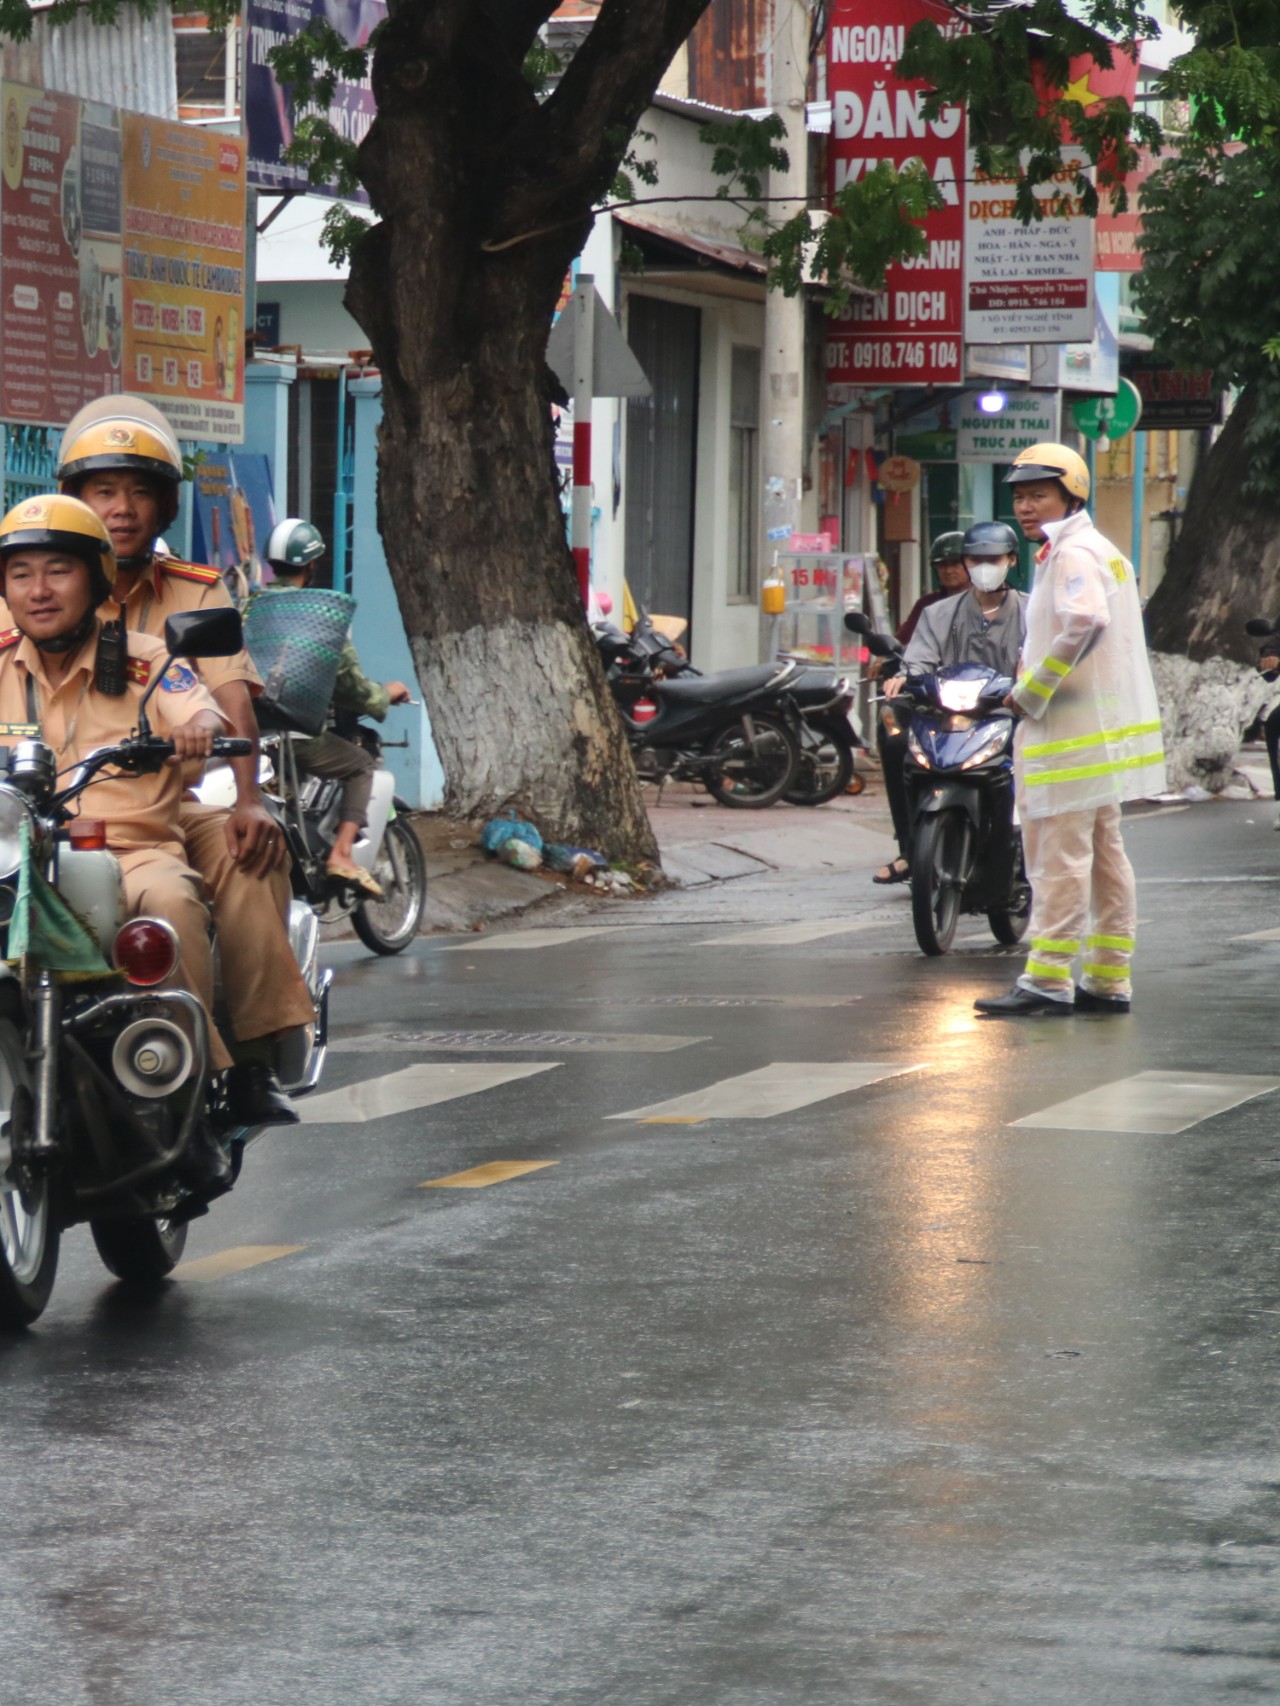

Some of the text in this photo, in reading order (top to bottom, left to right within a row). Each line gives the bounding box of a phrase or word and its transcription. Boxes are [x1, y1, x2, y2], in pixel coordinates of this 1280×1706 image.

[831, 25, 905, 71] NGOẠI
[832, 80, 962, 139] ĐĂNG
[969, 199, 1017, 224] DỊCH
[983, 226, 1006, 237] ANH
[1013, 226, 1041, 236] PHÁP
[977, 242, 1000, 251] HOA
[1008, 239, 1030, 249] HÀN
[1039, 240, 1061, 249] NGA
[1011, 253, 1032, 263] TÂY
[1034, 253, 1056, 262] BAN
[1058, 253, 1081, 262] NHA
[1000, 268, 1019, 277] LAI
[894, 291, 946, 328] DỊCH
[853, 341, 925, 369] 0918.746
[929, 340, 958, 369] 104
